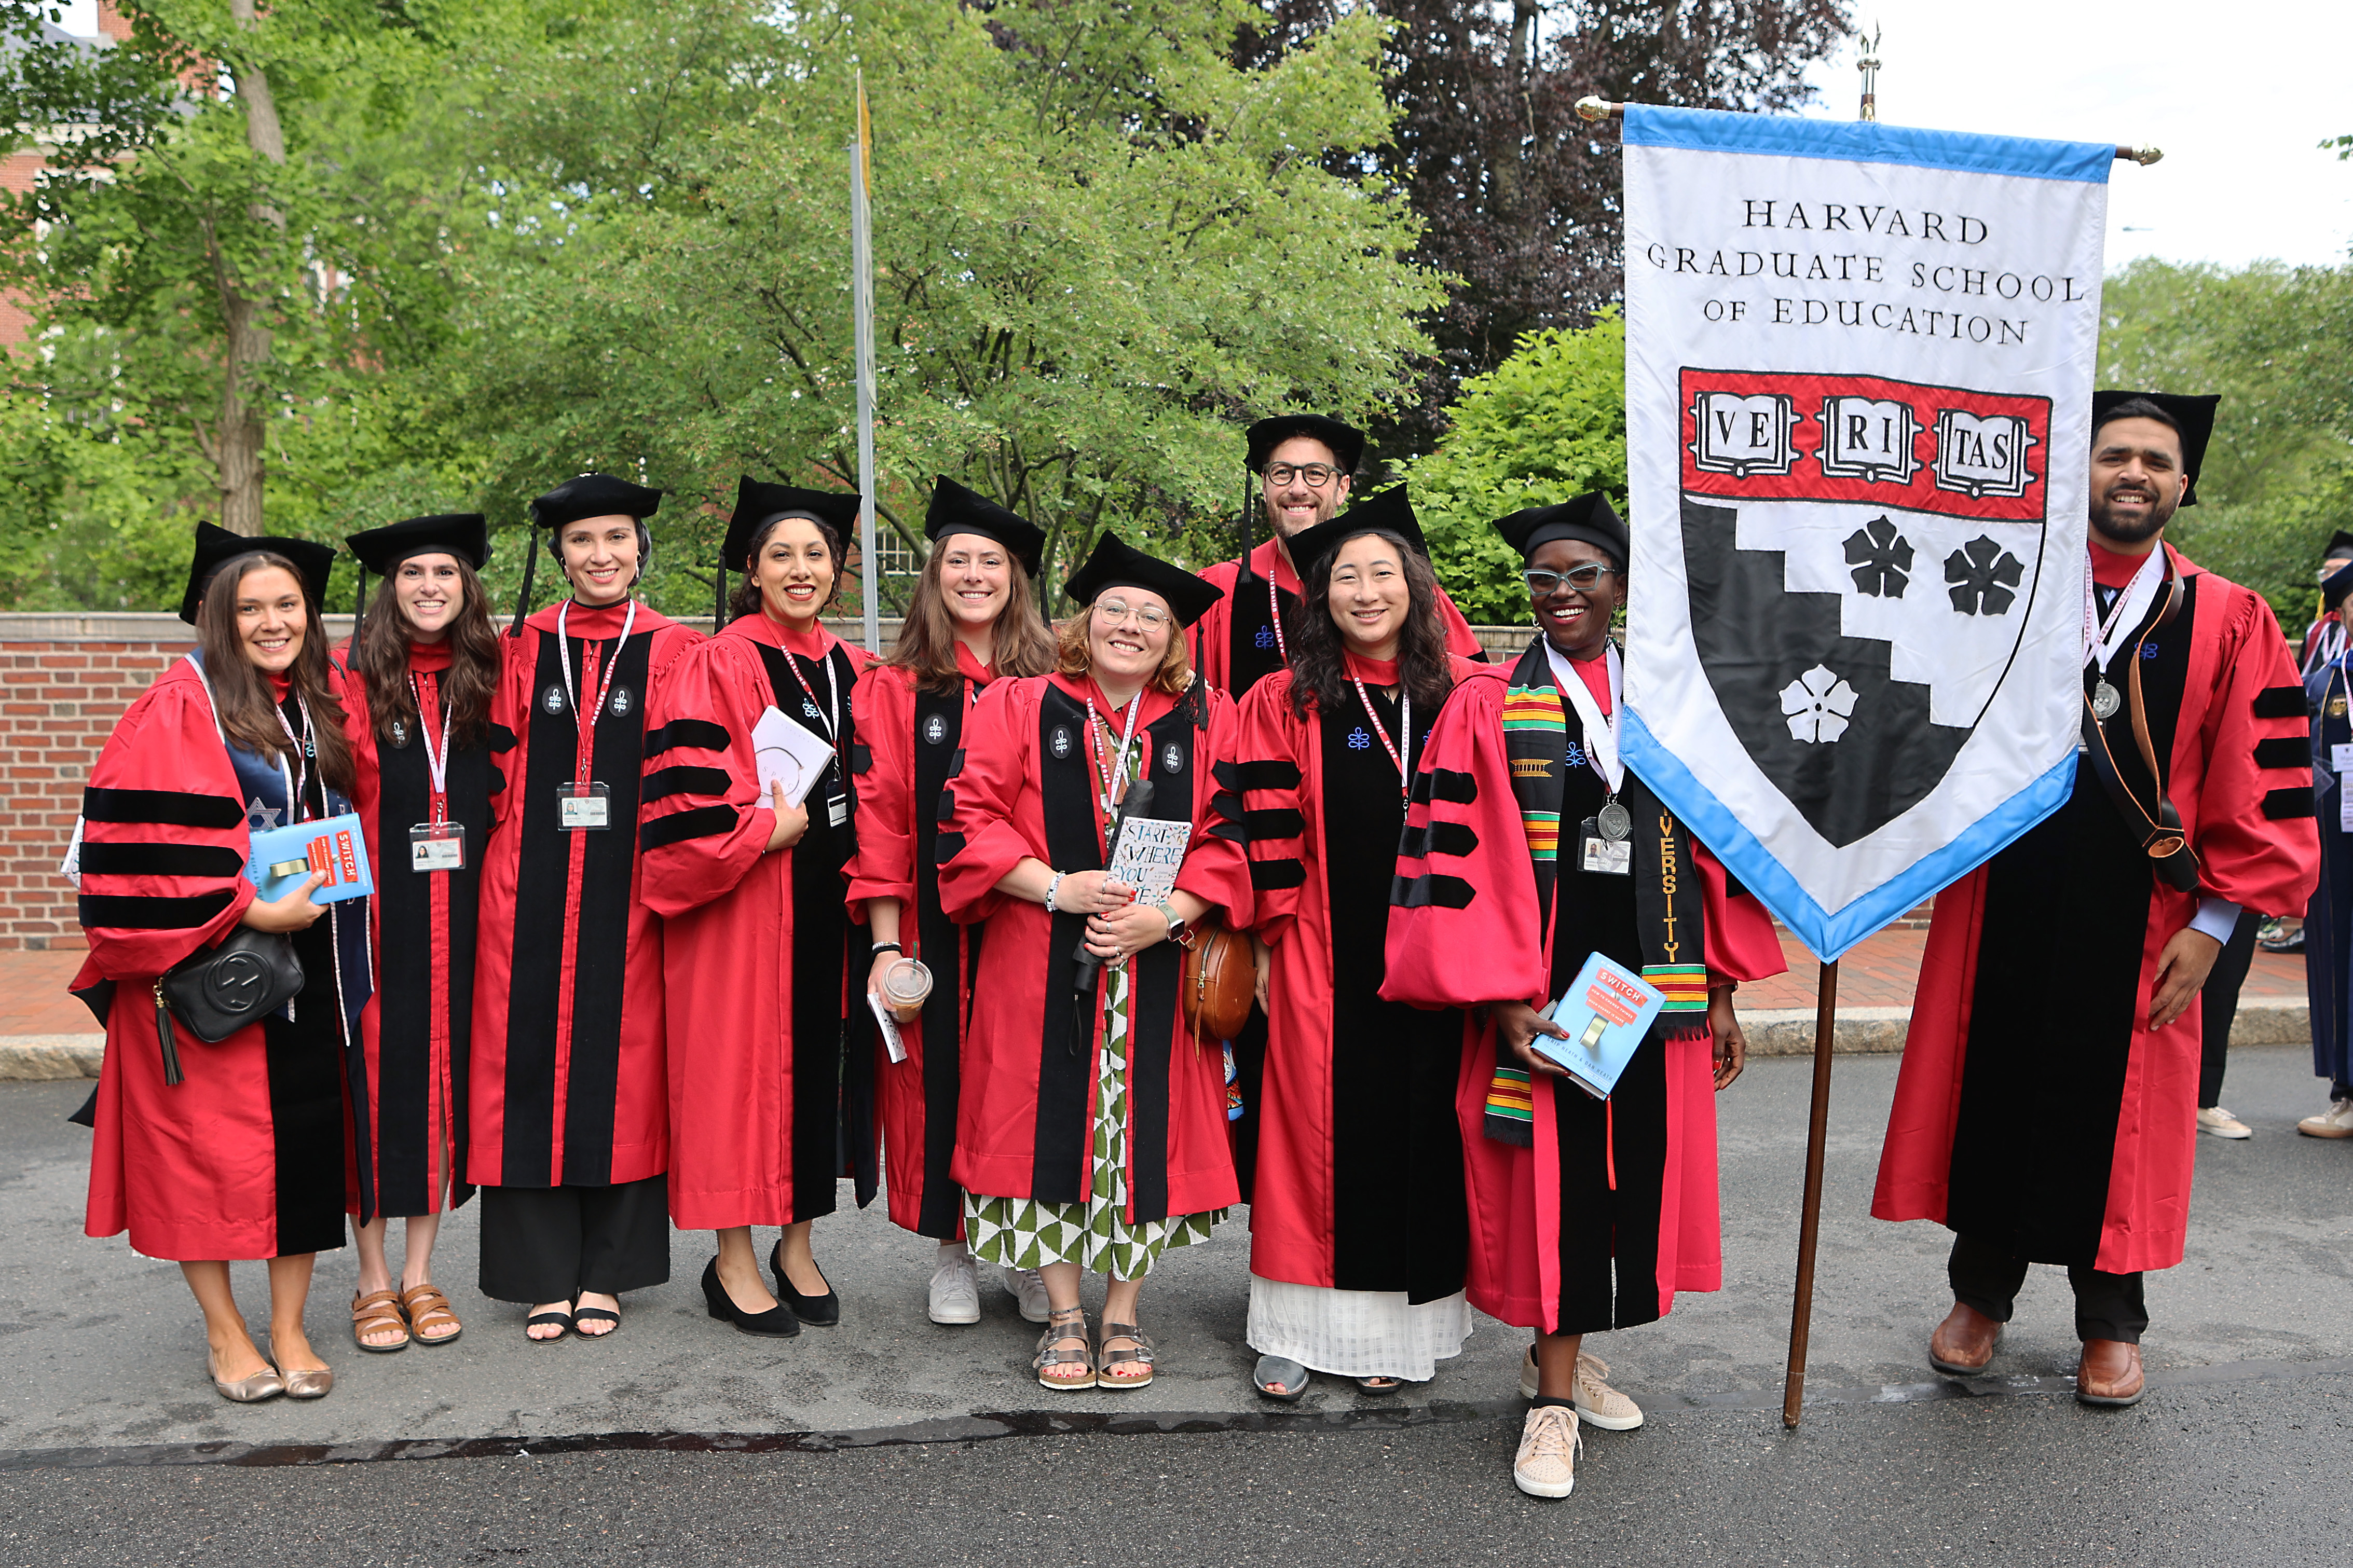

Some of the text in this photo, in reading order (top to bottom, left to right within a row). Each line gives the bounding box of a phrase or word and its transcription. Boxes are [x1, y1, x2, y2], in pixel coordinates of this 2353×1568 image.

[1743, 200, 1989, 245] HARVARD
[1648, 242, 2085, 302] GRADUATE SCHOOL
[1704, 298, 2029, 346] OF EDUCATION
[1715, 410, 2010, 470] VE RI TAS
[1274, 618, 1284, 653] HARVARD
[781, 644, 807, 686] UNIVERSITY
[591, 691, 607, 726] HARVARD
[1354, 677, 1398, 759] COMMENCEMENT 2025
[1087, 697, 1110, 784] COMMENCEMENT 2025
[758, 762, 802, 794] SPECT
[1128, 824, 1168, 843] START
[338, 833, 356, 877] SWITCH
[1129, 846, 1182, 864] WHERE
[1119, 866, 1148, 882] YOU
[1132, 887, 1151, 905] RE
[1599, 971, 1641, 1001] SWITCH
[1625, 975, 1636, 984] TIMES
[1636, 981, 1658, 999] BESTSELLER
[1604, 998, 1620, 1009] CHANGE
[1619, 1008, 1633, 1019] THINGS
[1547, 1037, 1560, 1047] CHIP
[1561, 1046, 1578, 1058] HEATH
[1584, 1061, 1595, 1070] DAN
[1596, 1068, 1613, 1081] HEATH
